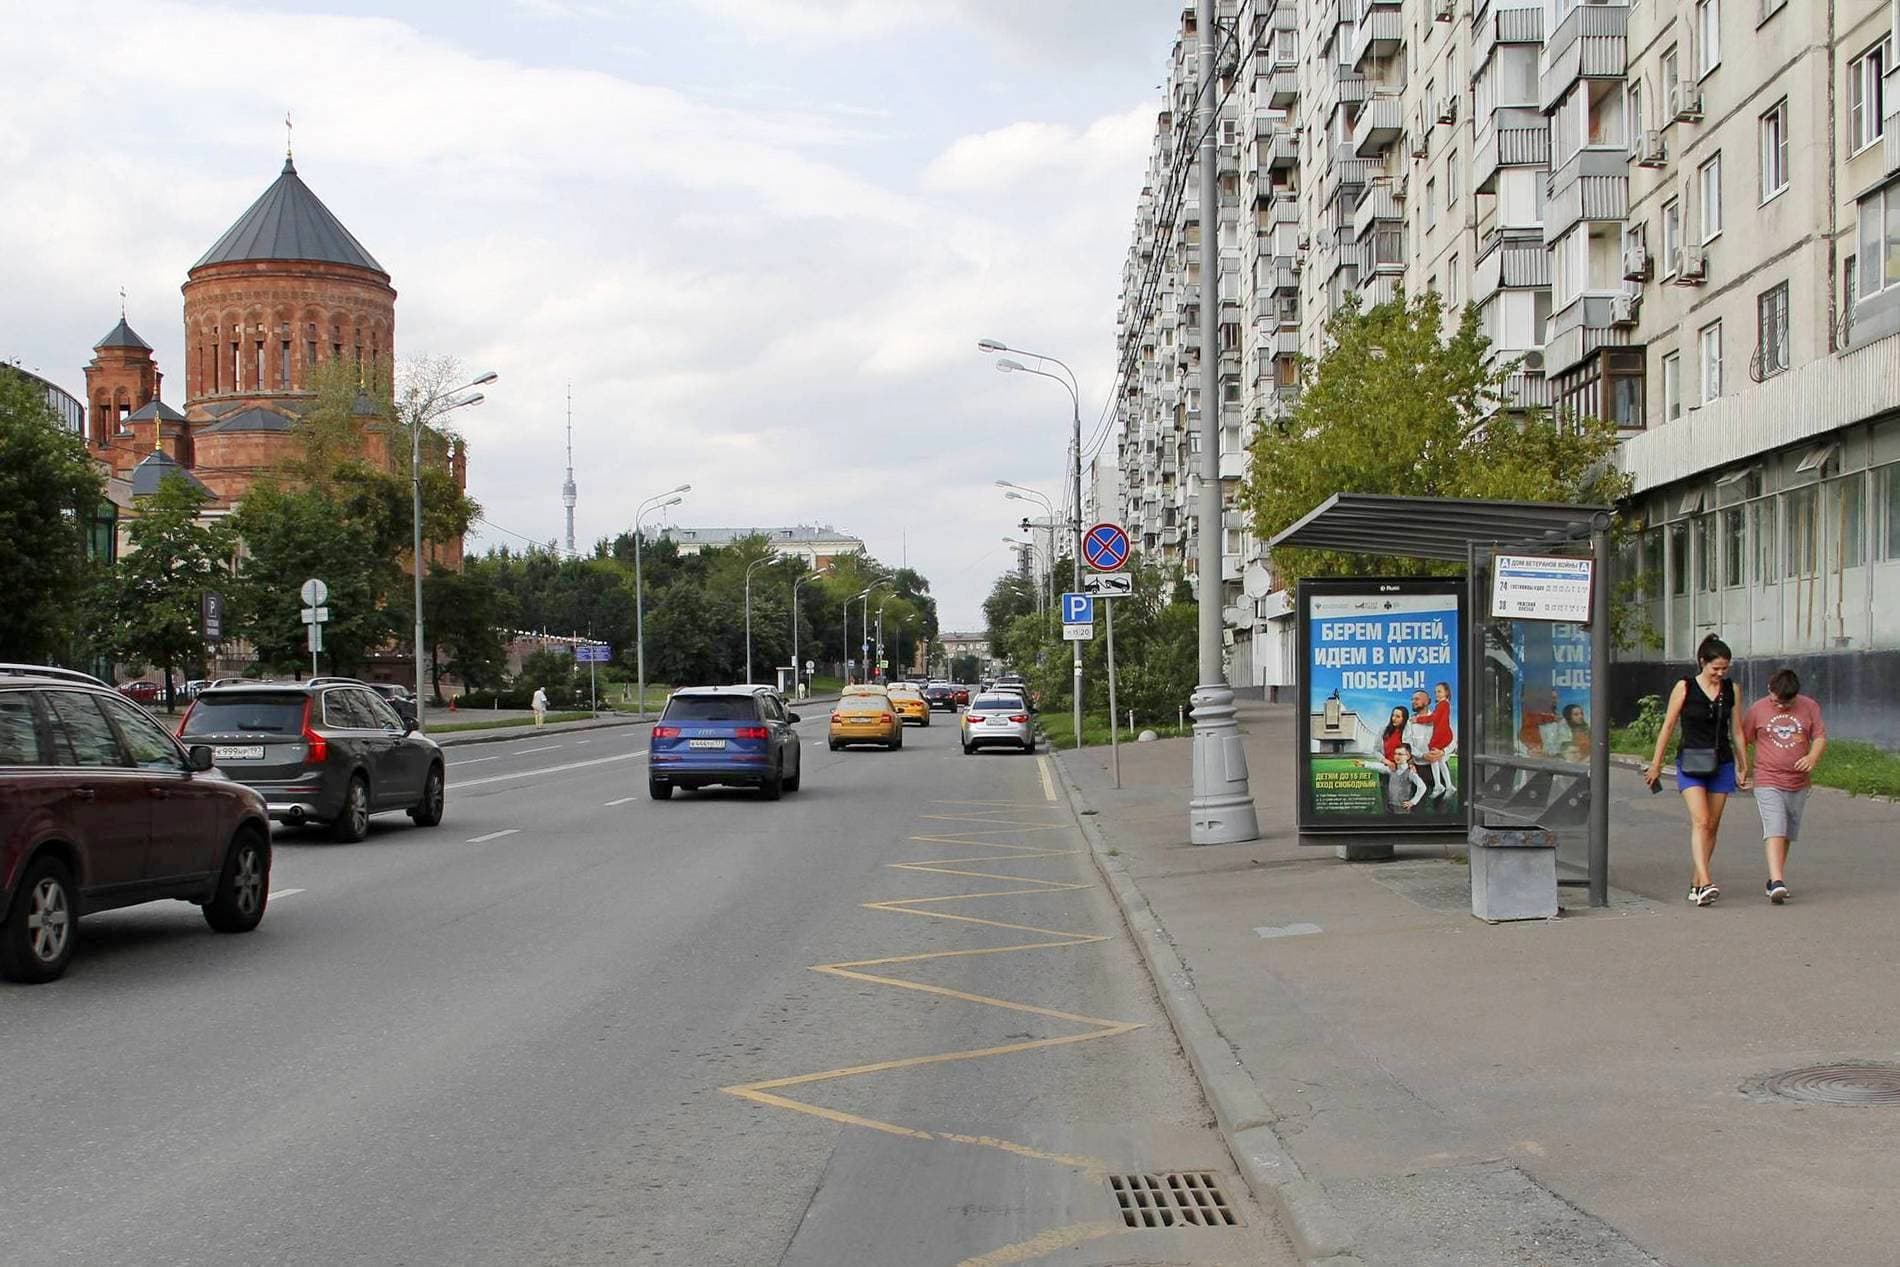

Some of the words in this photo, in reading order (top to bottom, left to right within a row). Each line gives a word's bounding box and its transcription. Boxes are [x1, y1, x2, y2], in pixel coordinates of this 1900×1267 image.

[1071, 597, 1087, 620] P
[1080, 628, 1090, 636] 20
[1321, 622, 1382, 641] БЕРЕМ
[1387, 617, 1449, 643] ДЕТЕЙ,
[1314, 647, 1367, 669] ИДЕМ
[1373, 647, 1385, 665] В
[1389, 643, 1450, 665] МУЗЕЙ
[1341, 670, 1425, 692] ПОБЕДЫ!
[1315, 781, 1334, 789] ВХОД
[1334, 780, 1376, 789] СВОБОДНЫЙ
[1340, 772, 1349, 781] ДО
[1359, 772, 1372, 780] ЛЕТ
